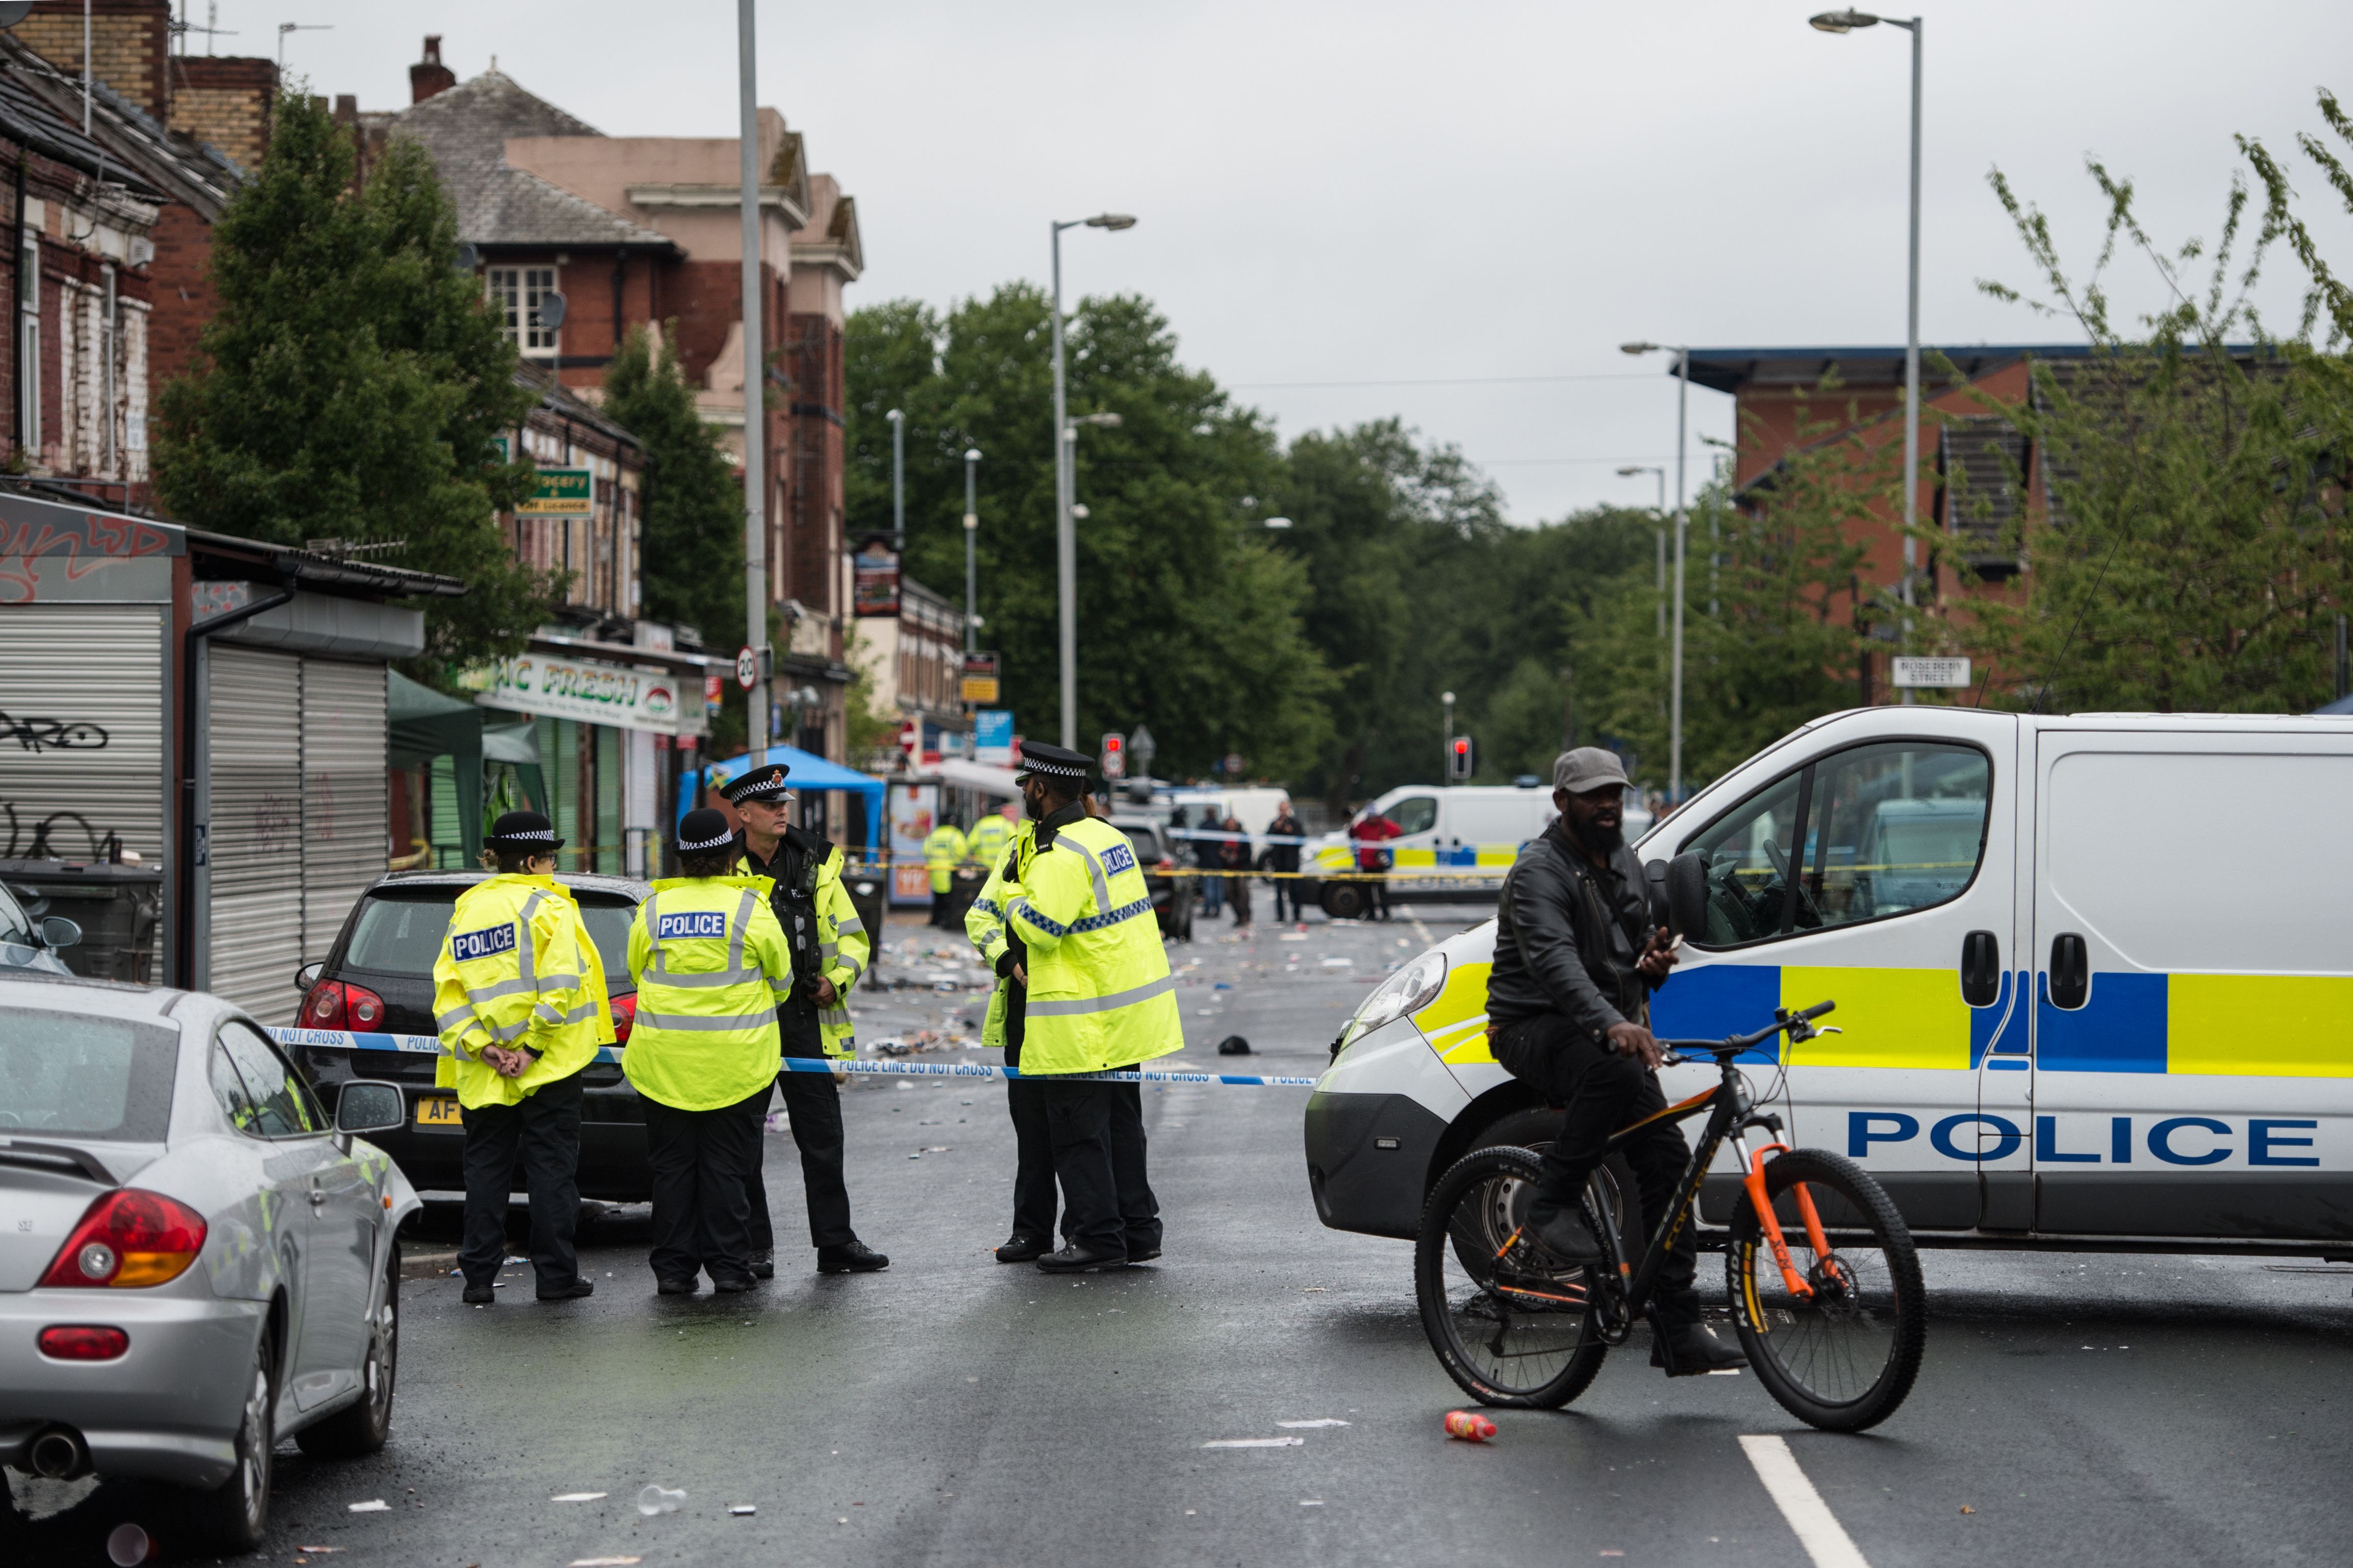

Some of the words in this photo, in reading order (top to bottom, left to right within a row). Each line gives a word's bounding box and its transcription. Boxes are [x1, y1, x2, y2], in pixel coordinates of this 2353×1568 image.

[540, 475, 587, 490] ocery
[739, 658, 753, 677] 20
[1901, 661, 1963, 671] ROSEBERY
[542, 664, 638, 707] FRESH
[1910, 673, 1954, 682] STREET
[1102, 846, 1133, 873] POLICE
[661, 915, 723, 935] POLICE
[456, 927, 513, 958] POLICE
[281, 1029, 305, 1042] NOT
[307, 1031, 345, 1045] CROSS
[407, 1036, 440, 1051] POLIC
[839, 1061, 878, 1071] POLICE
[882, 1062, 906, 1073] LINE
[910, 1063, 925, 1074] DO
[929, 1064, 950, 1074] NOT
[955, 1065, 993, 1076] CROSS
[429, 1100, 462, 1119] AF
[1848, 1112, 2320, 1166] POLICE
[1499, 1164, 1540, 1185] KEN
[1772, 1240, 1791, 1270] XCM
[1731, 1240, 1749, 1327] KENDA
[1512, 1292, 1557, 1305] carrera
